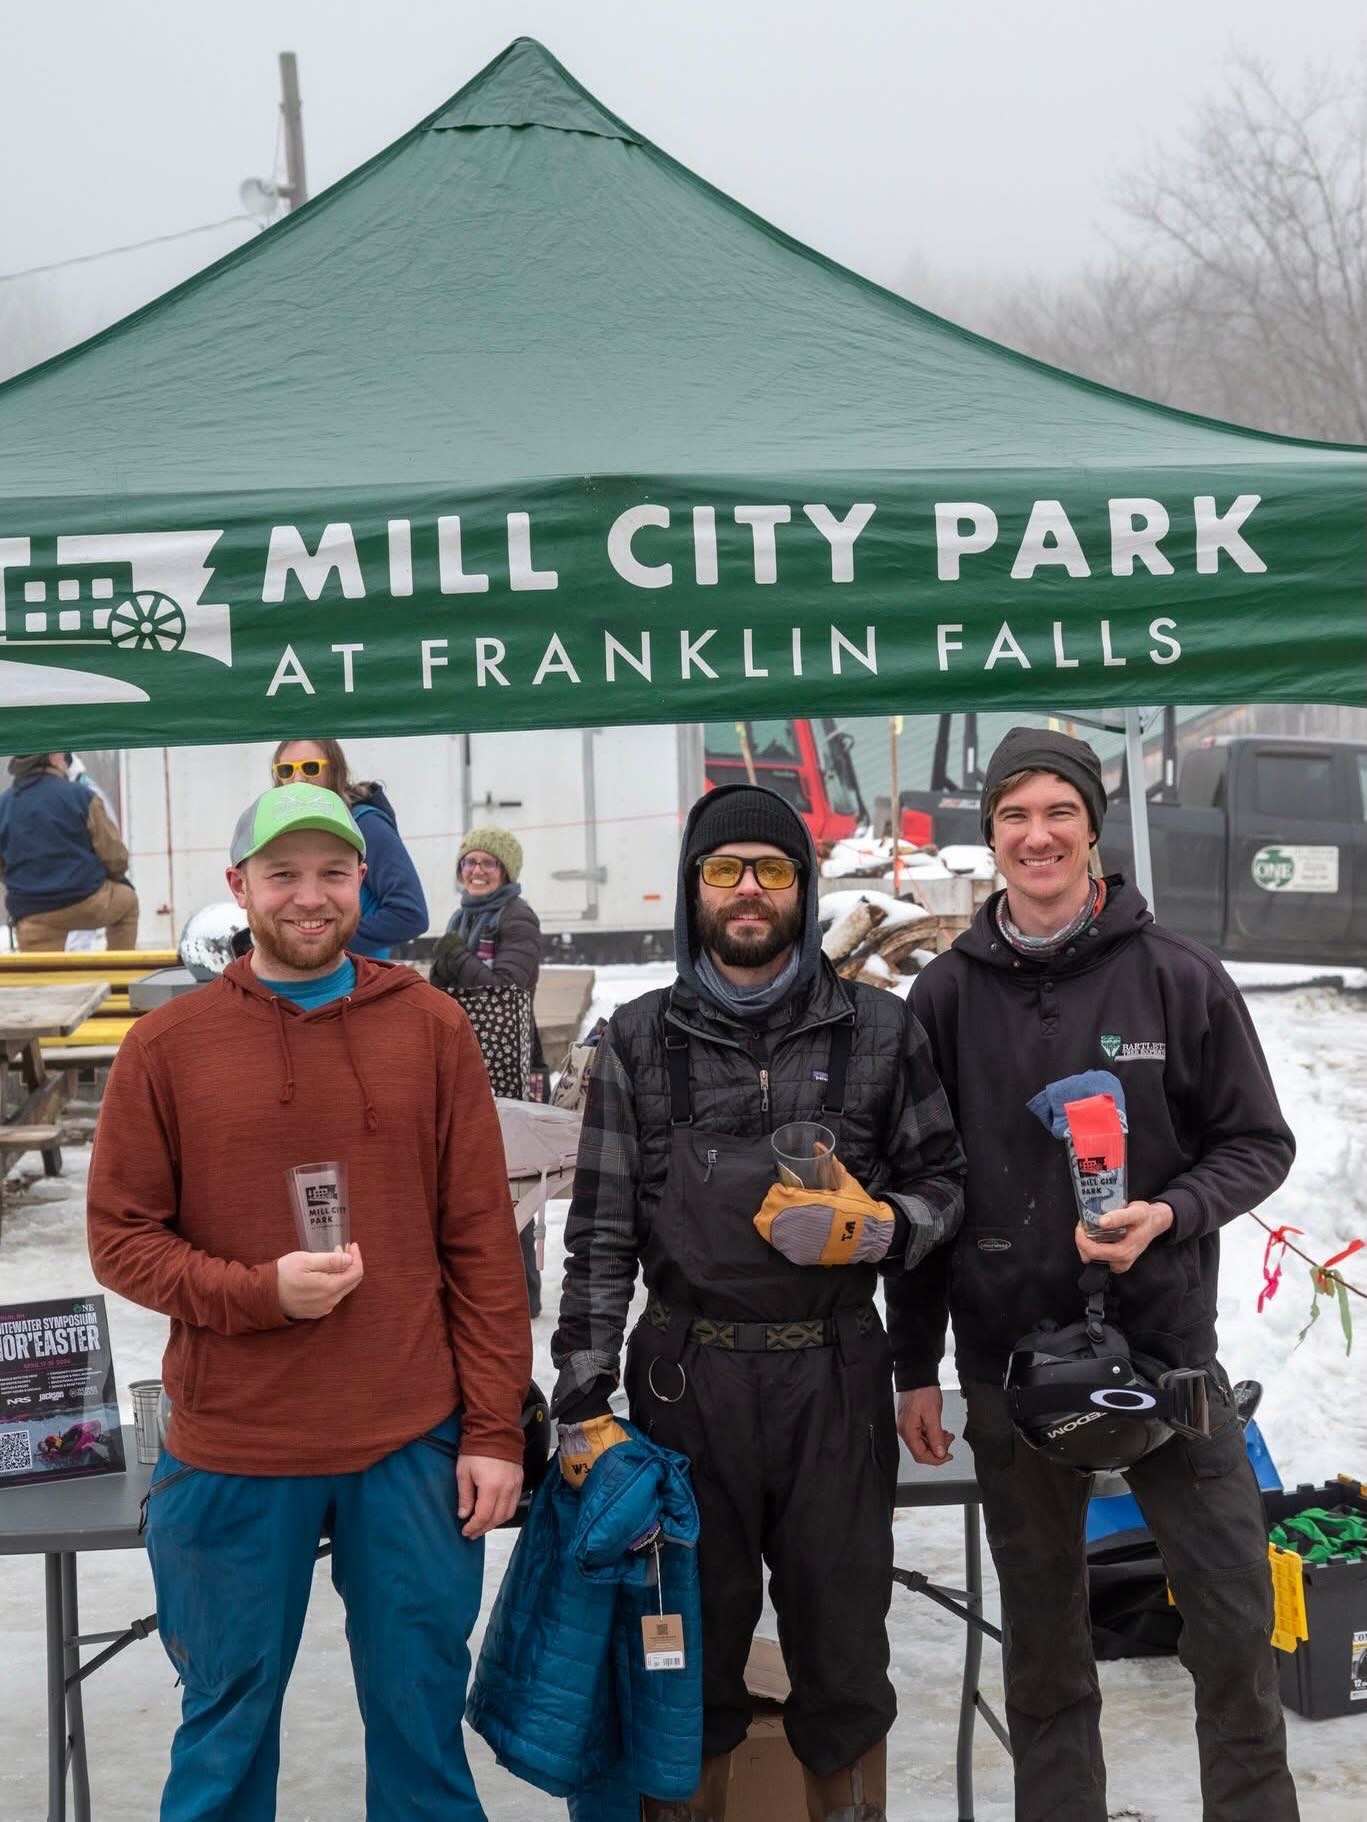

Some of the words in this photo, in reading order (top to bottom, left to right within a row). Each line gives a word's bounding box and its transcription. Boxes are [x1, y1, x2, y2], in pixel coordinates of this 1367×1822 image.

[262, 512, 558, 602] MILL
[608, 504, 876, 588] CITY
[935, 495, 1267, 580] PARK
[266, 644, 363, 695] AT
[422, 625, 877, 688] FRANKLIN
[938, 618, 1181, 670] FALLS
[1081, 1178, 1098, 1187] MILL
[1100, 1177, 1118, 1185] CITY
[1082, 1187, 1102, 1195] PARK
[309, 1207, 329, 1216] MILL
[310, 1215, 333, 1224] PARK
[43, 1312, 98, 1330] SYMPOSIUM
